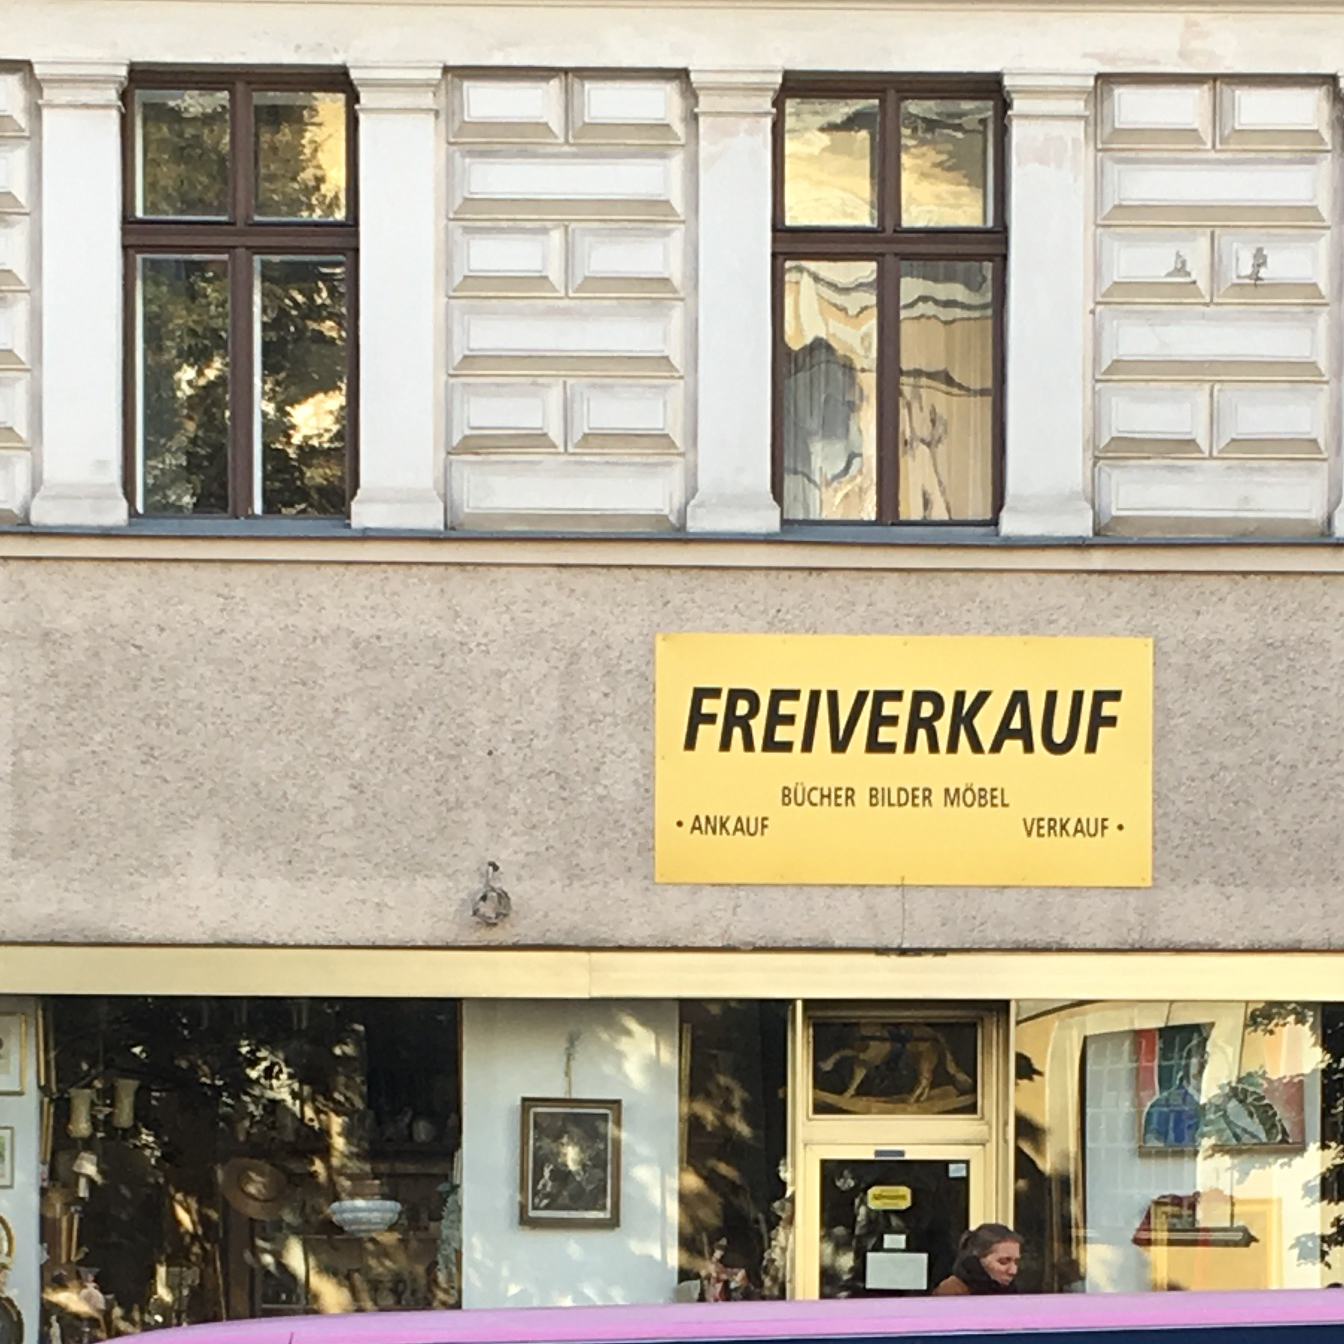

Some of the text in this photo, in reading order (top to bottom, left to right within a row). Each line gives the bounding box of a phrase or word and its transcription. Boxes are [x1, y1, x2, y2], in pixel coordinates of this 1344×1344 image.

[682, 686, 1124, 756] FREIVERKAUF
[780, 782, 1010, 809] BÜCHER BILDER MÖBEL
[689, 814, 770, 838] ANKAUF
[1022, 817, 1111, 839] VERKAUF
